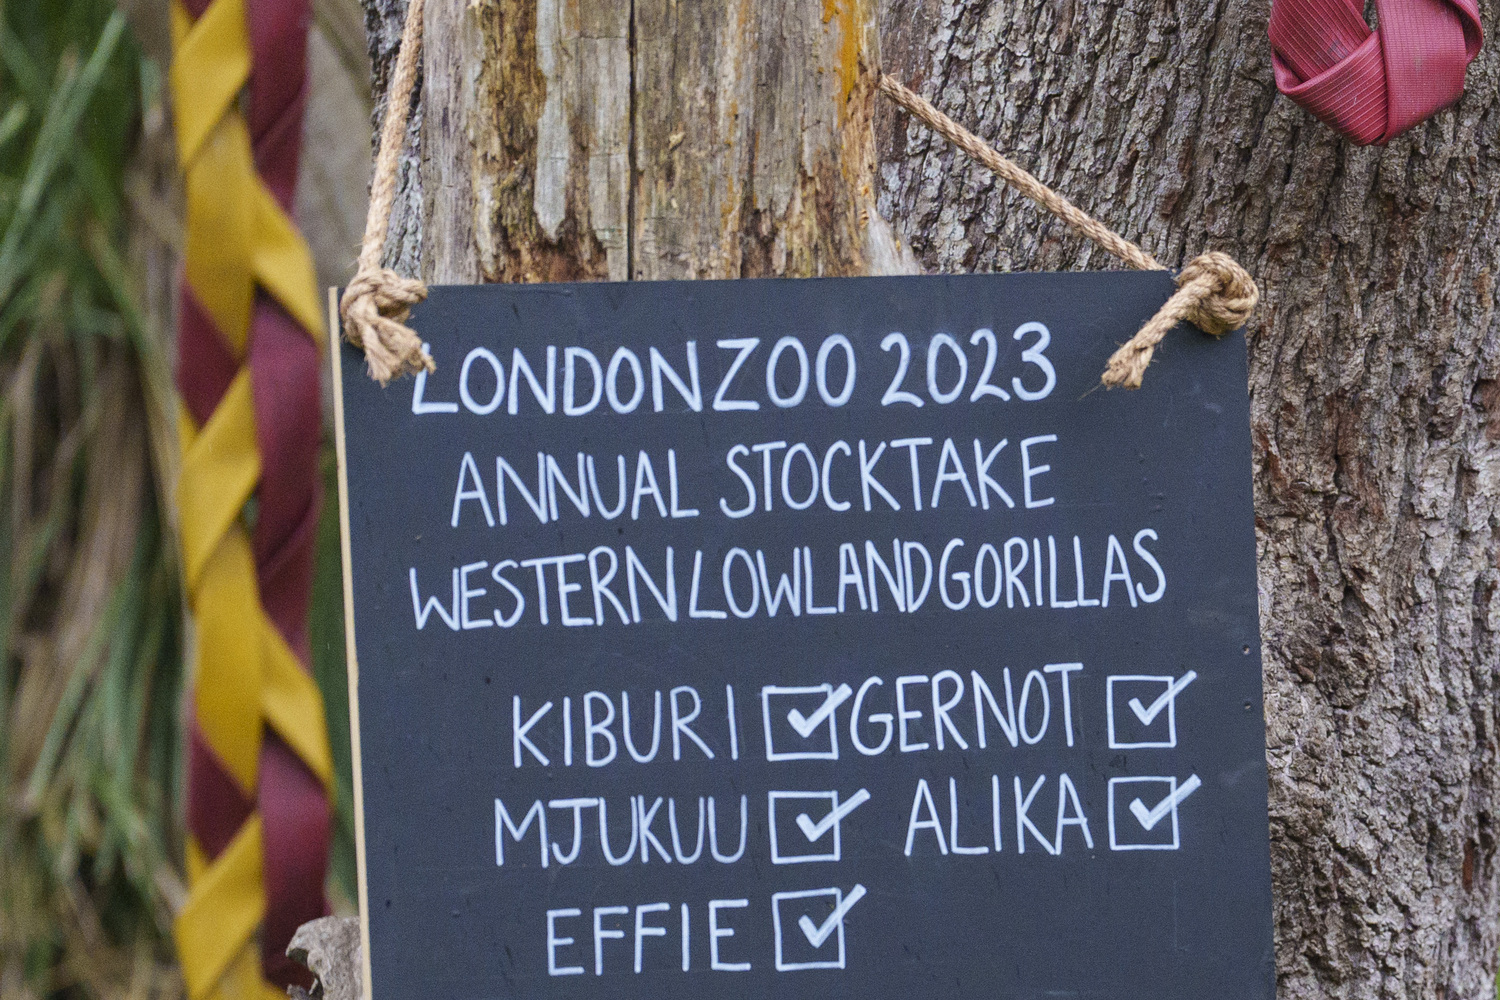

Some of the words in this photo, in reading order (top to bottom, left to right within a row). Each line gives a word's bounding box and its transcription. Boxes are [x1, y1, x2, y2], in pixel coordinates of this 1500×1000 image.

[880, 321, 1057, 408] 2023
[450, 448, 700, 528] ANNUAL
[719, 434, 1059, 519] STOCKTAKE
[512, 684, 739, 769] KIBURI
[849, 662, 1084, 756] GERNOT
[494, 794, 748, 869] MJUKUU
[903, 773, 1094, 857] ALIKA
[546, 898, 752, 976] EFFIE
